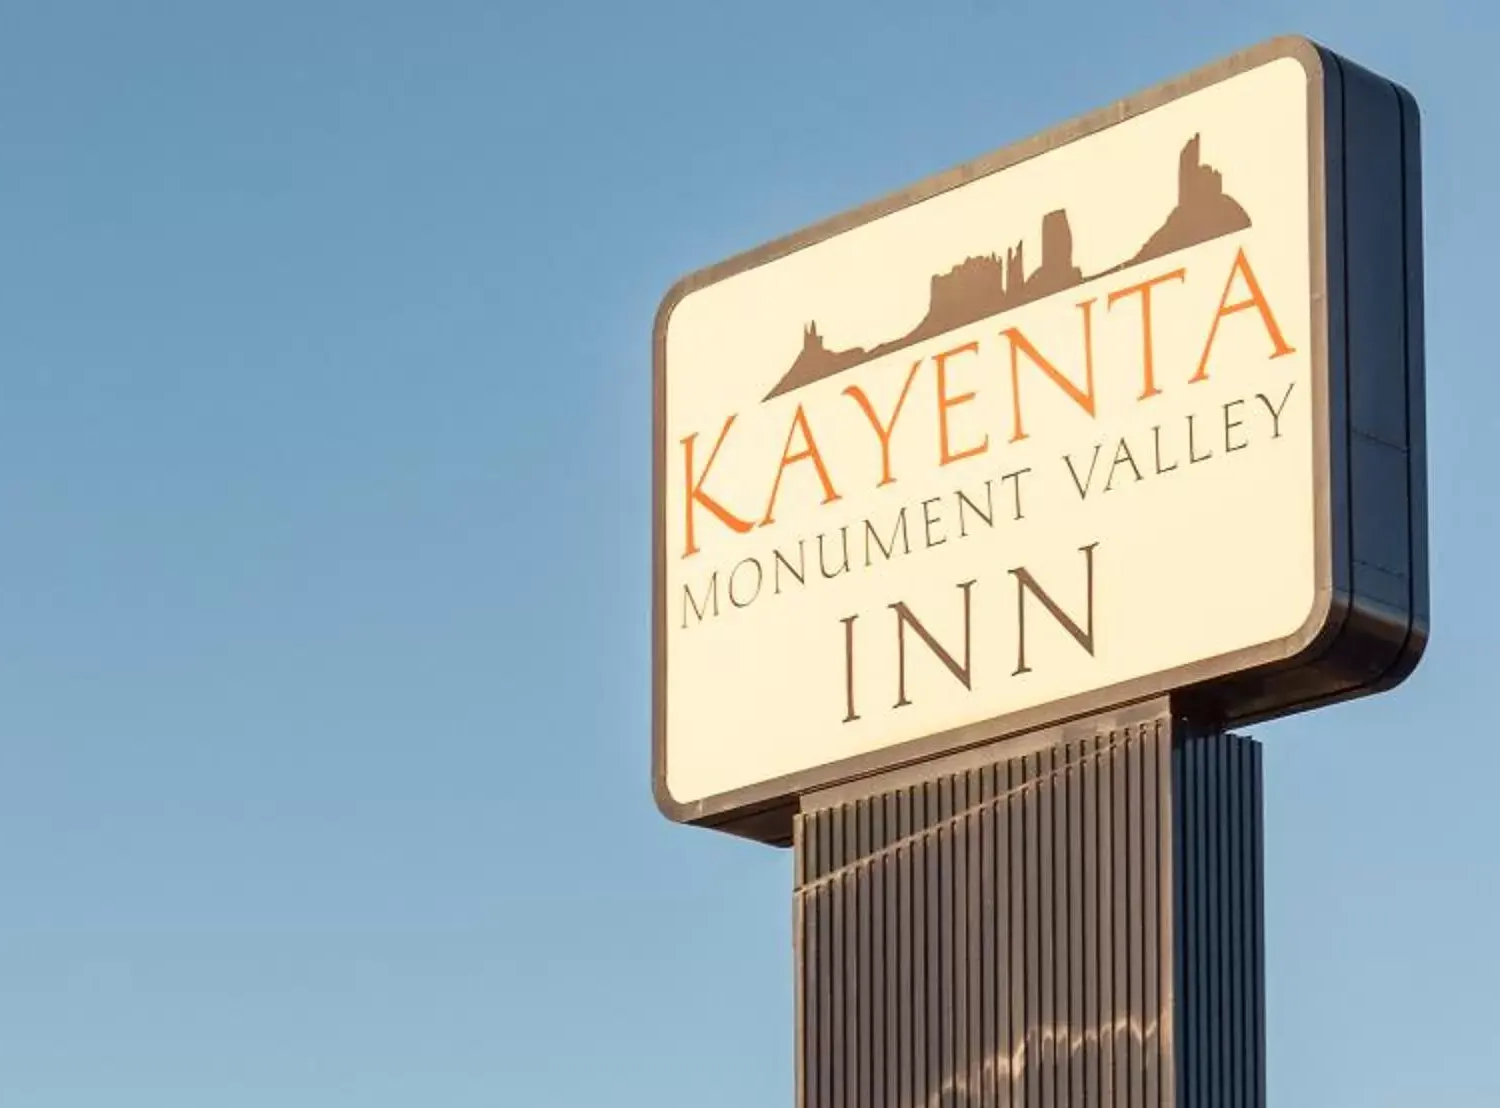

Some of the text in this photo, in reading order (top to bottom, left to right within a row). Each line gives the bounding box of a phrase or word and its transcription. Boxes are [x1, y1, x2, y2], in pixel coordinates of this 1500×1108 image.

[680, 246, 1297, 560] KAYENTA
[680, 383, 1296, 630] MONUMENT VALLEY
[839, 541, 1101, 724] INN
